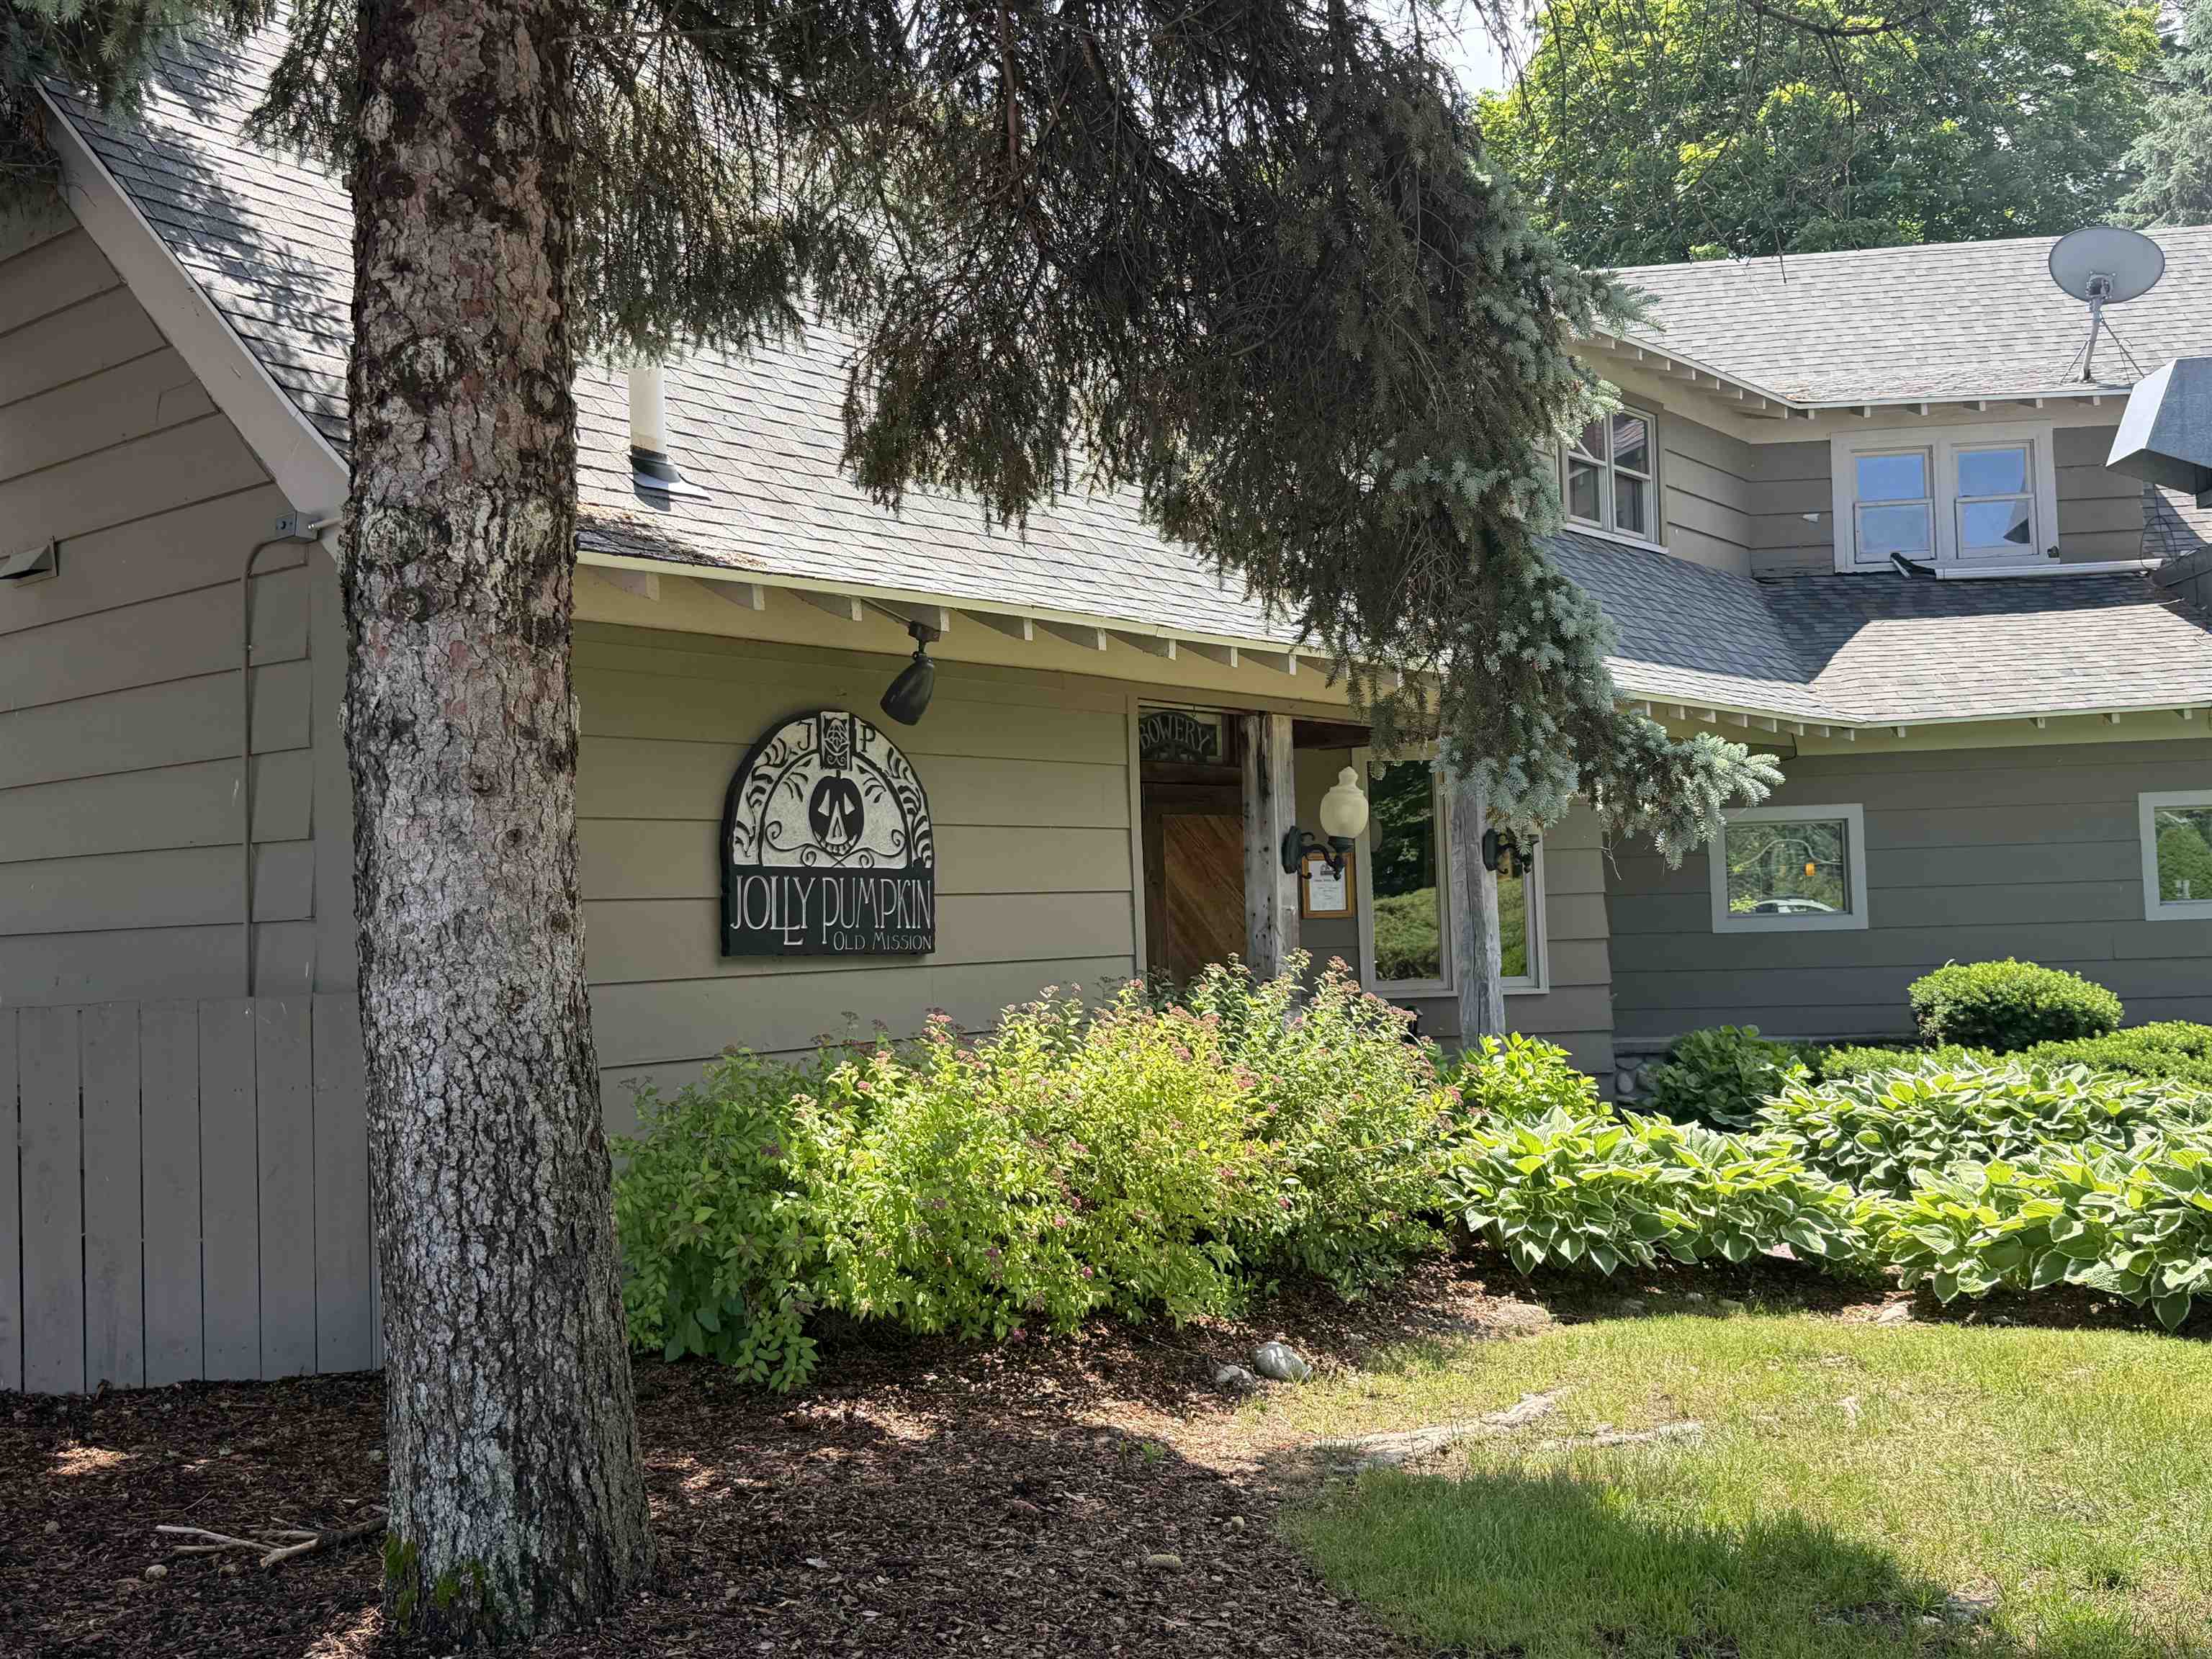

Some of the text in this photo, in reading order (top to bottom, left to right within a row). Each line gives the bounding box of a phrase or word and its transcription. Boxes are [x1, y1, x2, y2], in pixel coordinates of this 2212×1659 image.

[1139, 714, 1210, 755] BOWERY
[729, 874, 932, 946] JOLLY PUMPKIN
[833, 930, 932, 951] OLD MISSION
